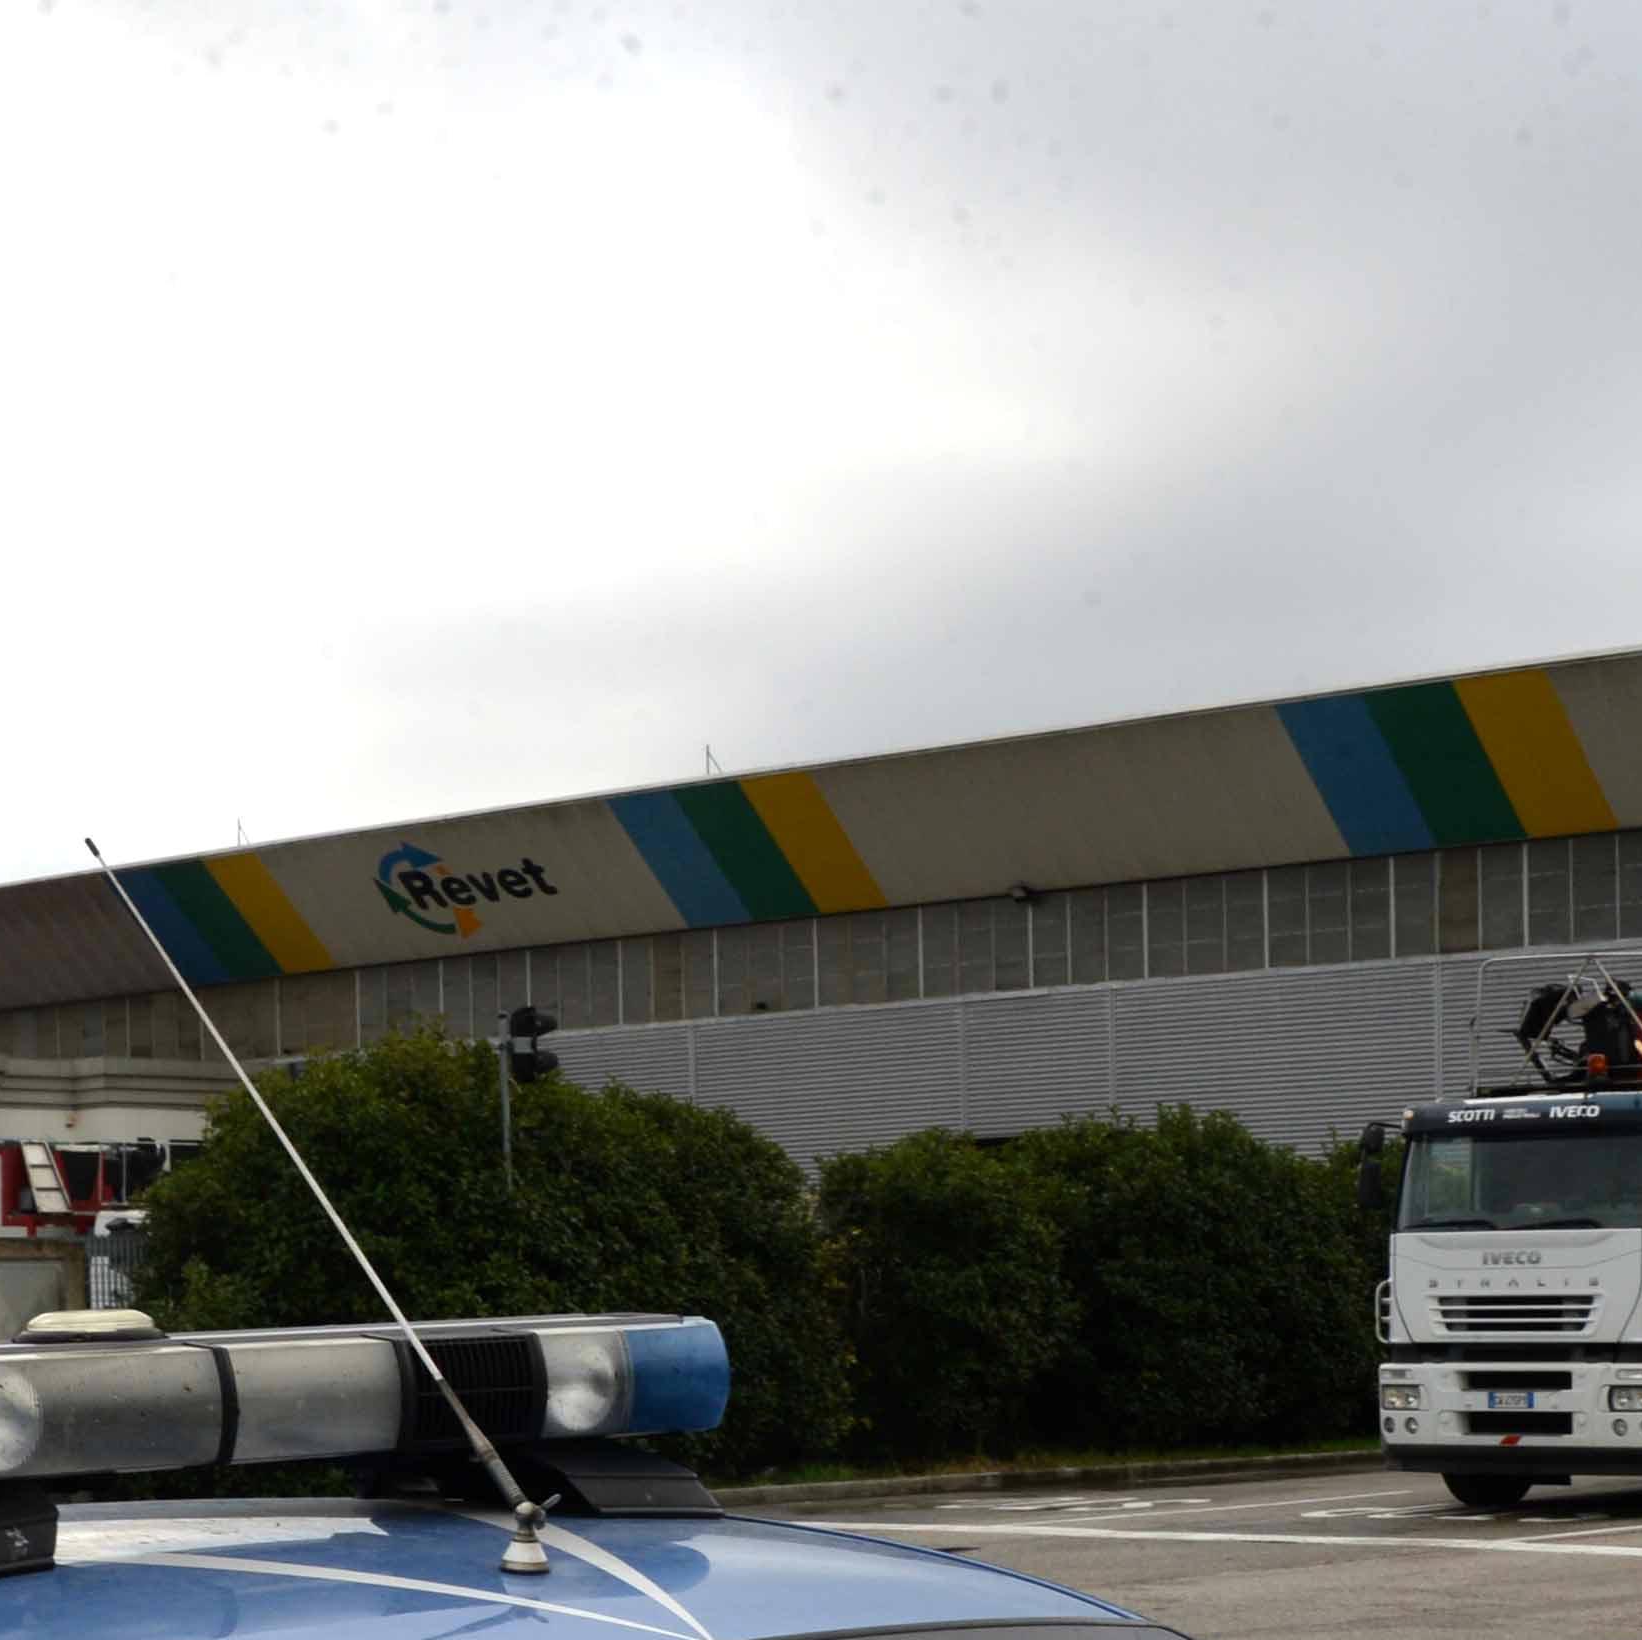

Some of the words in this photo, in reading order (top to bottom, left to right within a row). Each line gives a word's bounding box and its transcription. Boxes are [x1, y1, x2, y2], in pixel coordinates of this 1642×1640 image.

[397, 857, 558, 911] Revet
[1548, 1104, 1601, 1119] IVECO
[1481, 1250, 1542, 1266] IVECO
